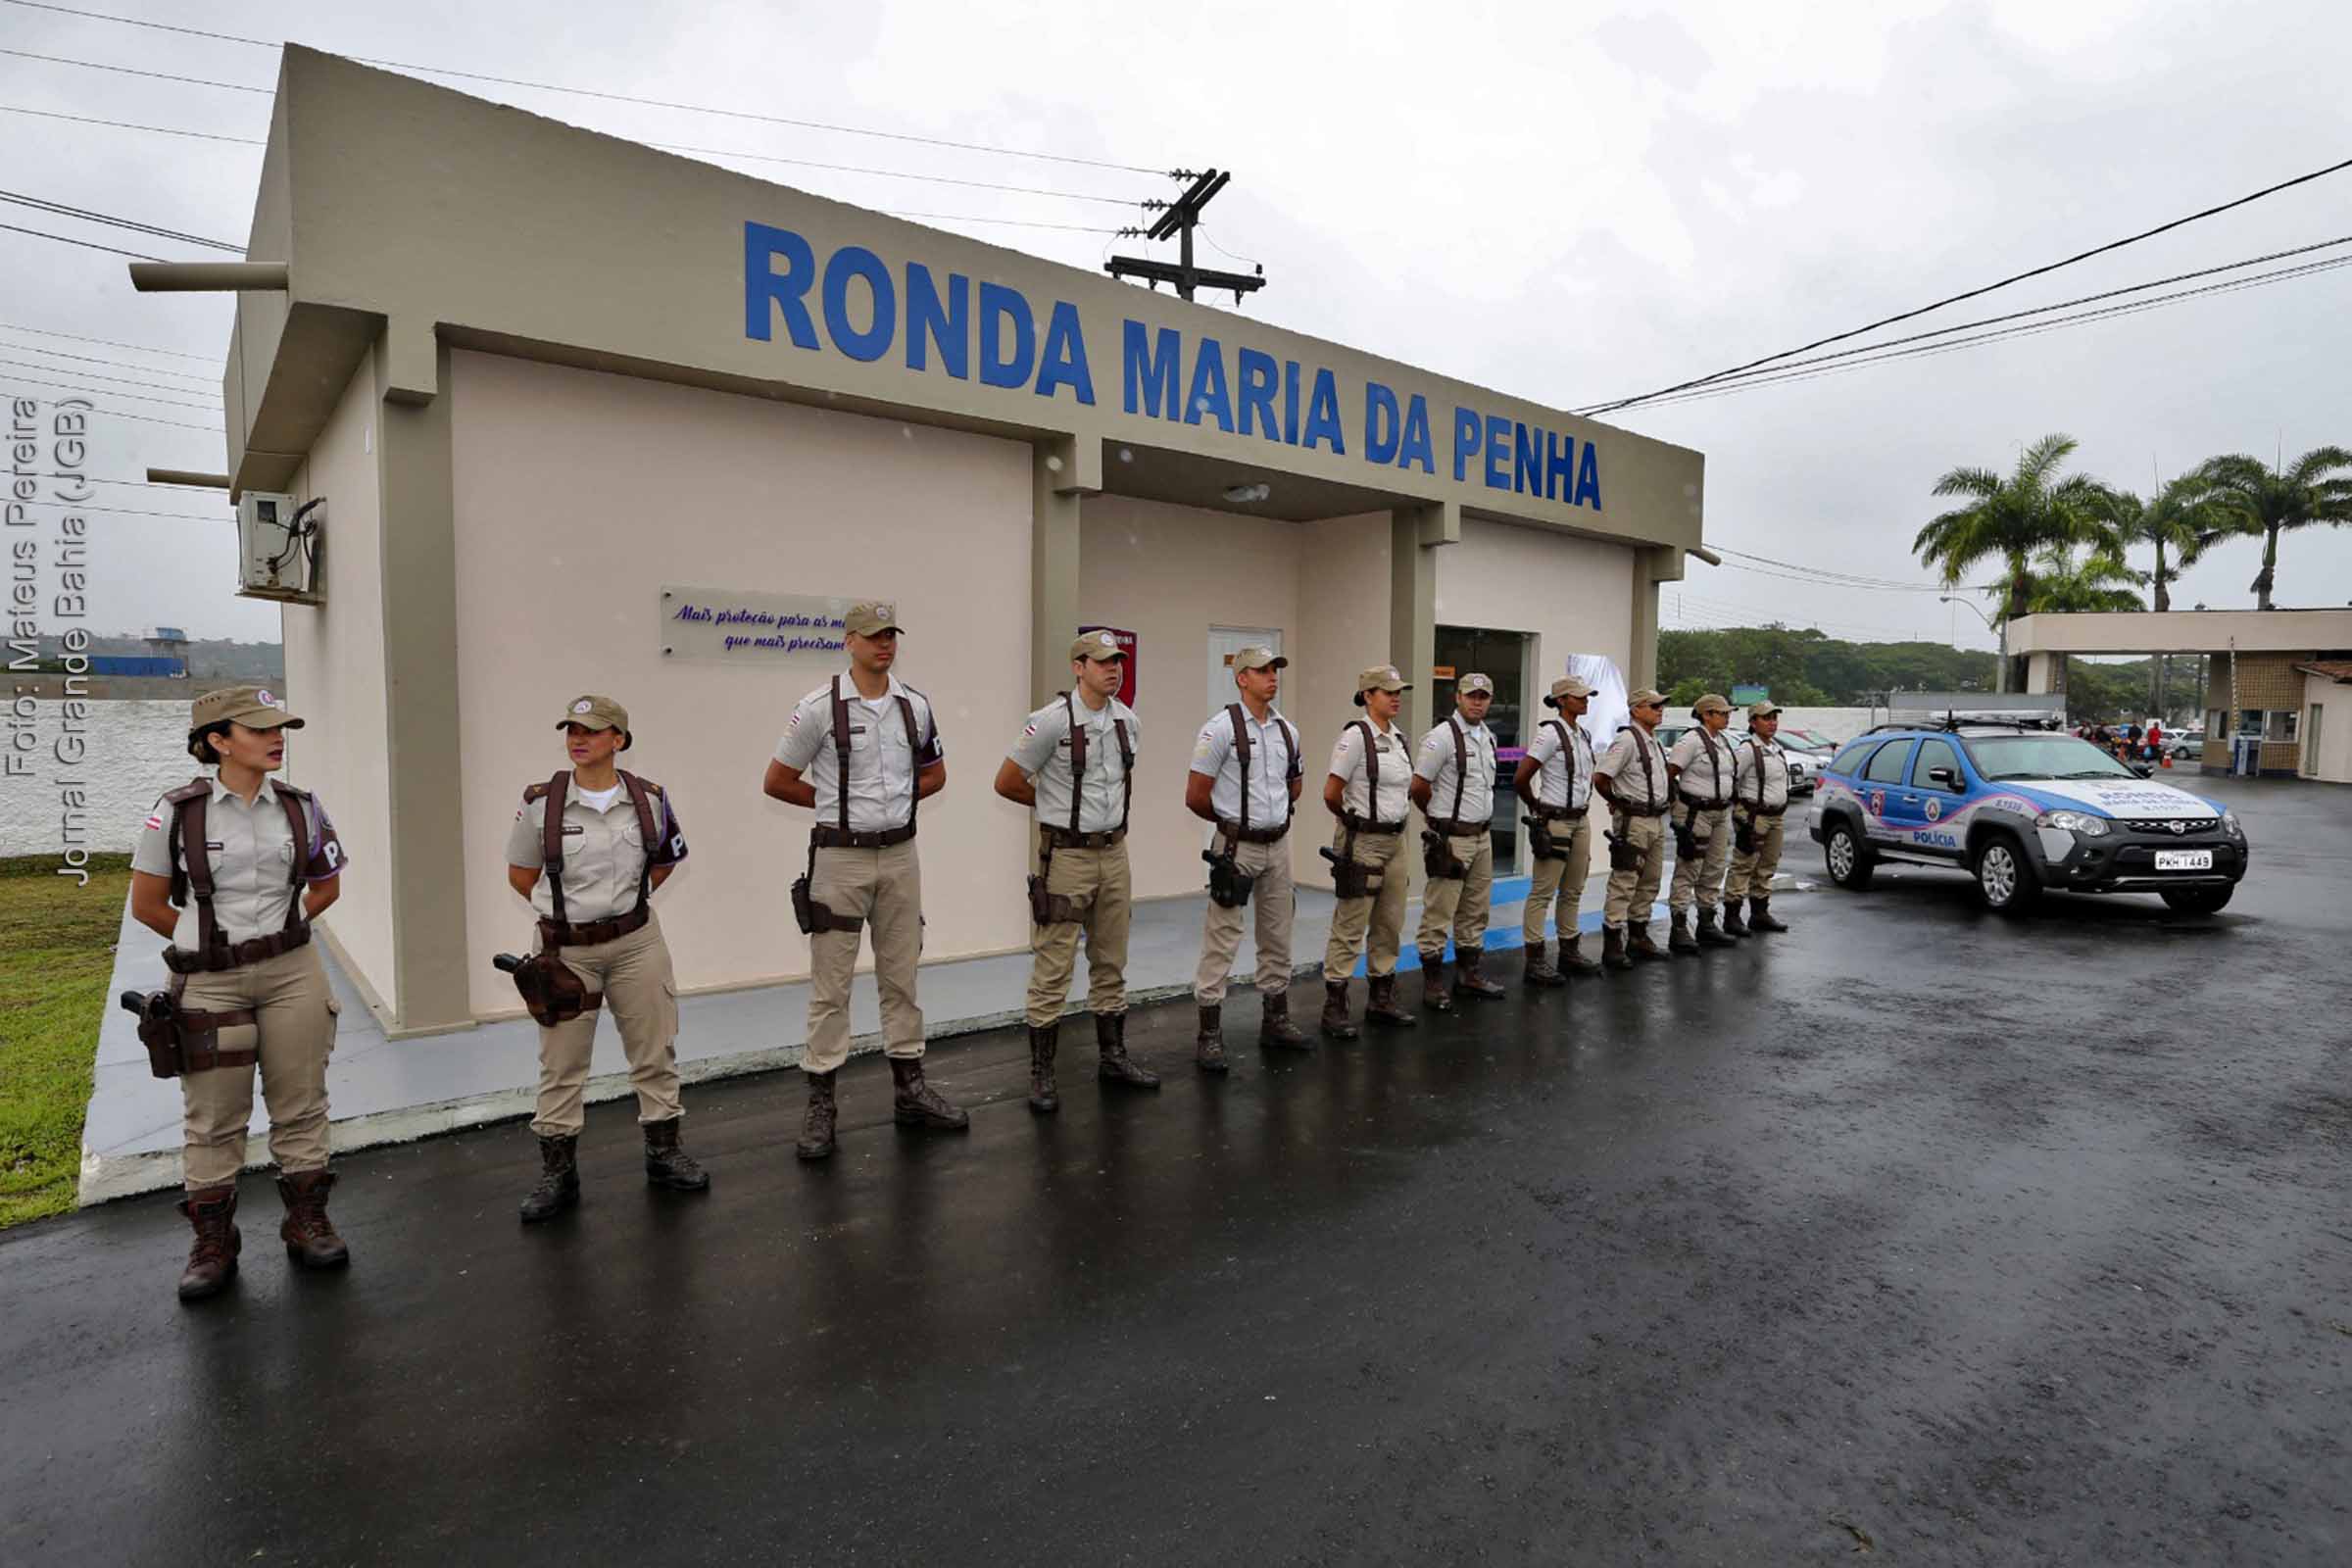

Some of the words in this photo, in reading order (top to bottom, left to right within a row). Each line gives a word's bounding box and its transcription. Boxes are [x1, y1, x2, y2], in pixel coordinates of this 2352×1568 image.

[745, 220, 1097, 407] RONDA
[1123, 318, 1347, 456] MARIA
[1364, 381, 1436, 475] DA
[1453, 407, 1602, 513] PENHA
[674, 605, 712, 621] Mais
[715, 608, 775, 625] proteção
[777, 614, 808, 629] para
[813, 616, 828, 628] as
[724, 634, 751, 651] que
[754, 636, 785, 648] mais
[788, 637, 845, 652] precisam
[1913, 830, 1957, 848] POLÍCIA
[2159, 858, 2180, 867] PKH
[2184, 857, 2210, 867] 1449
